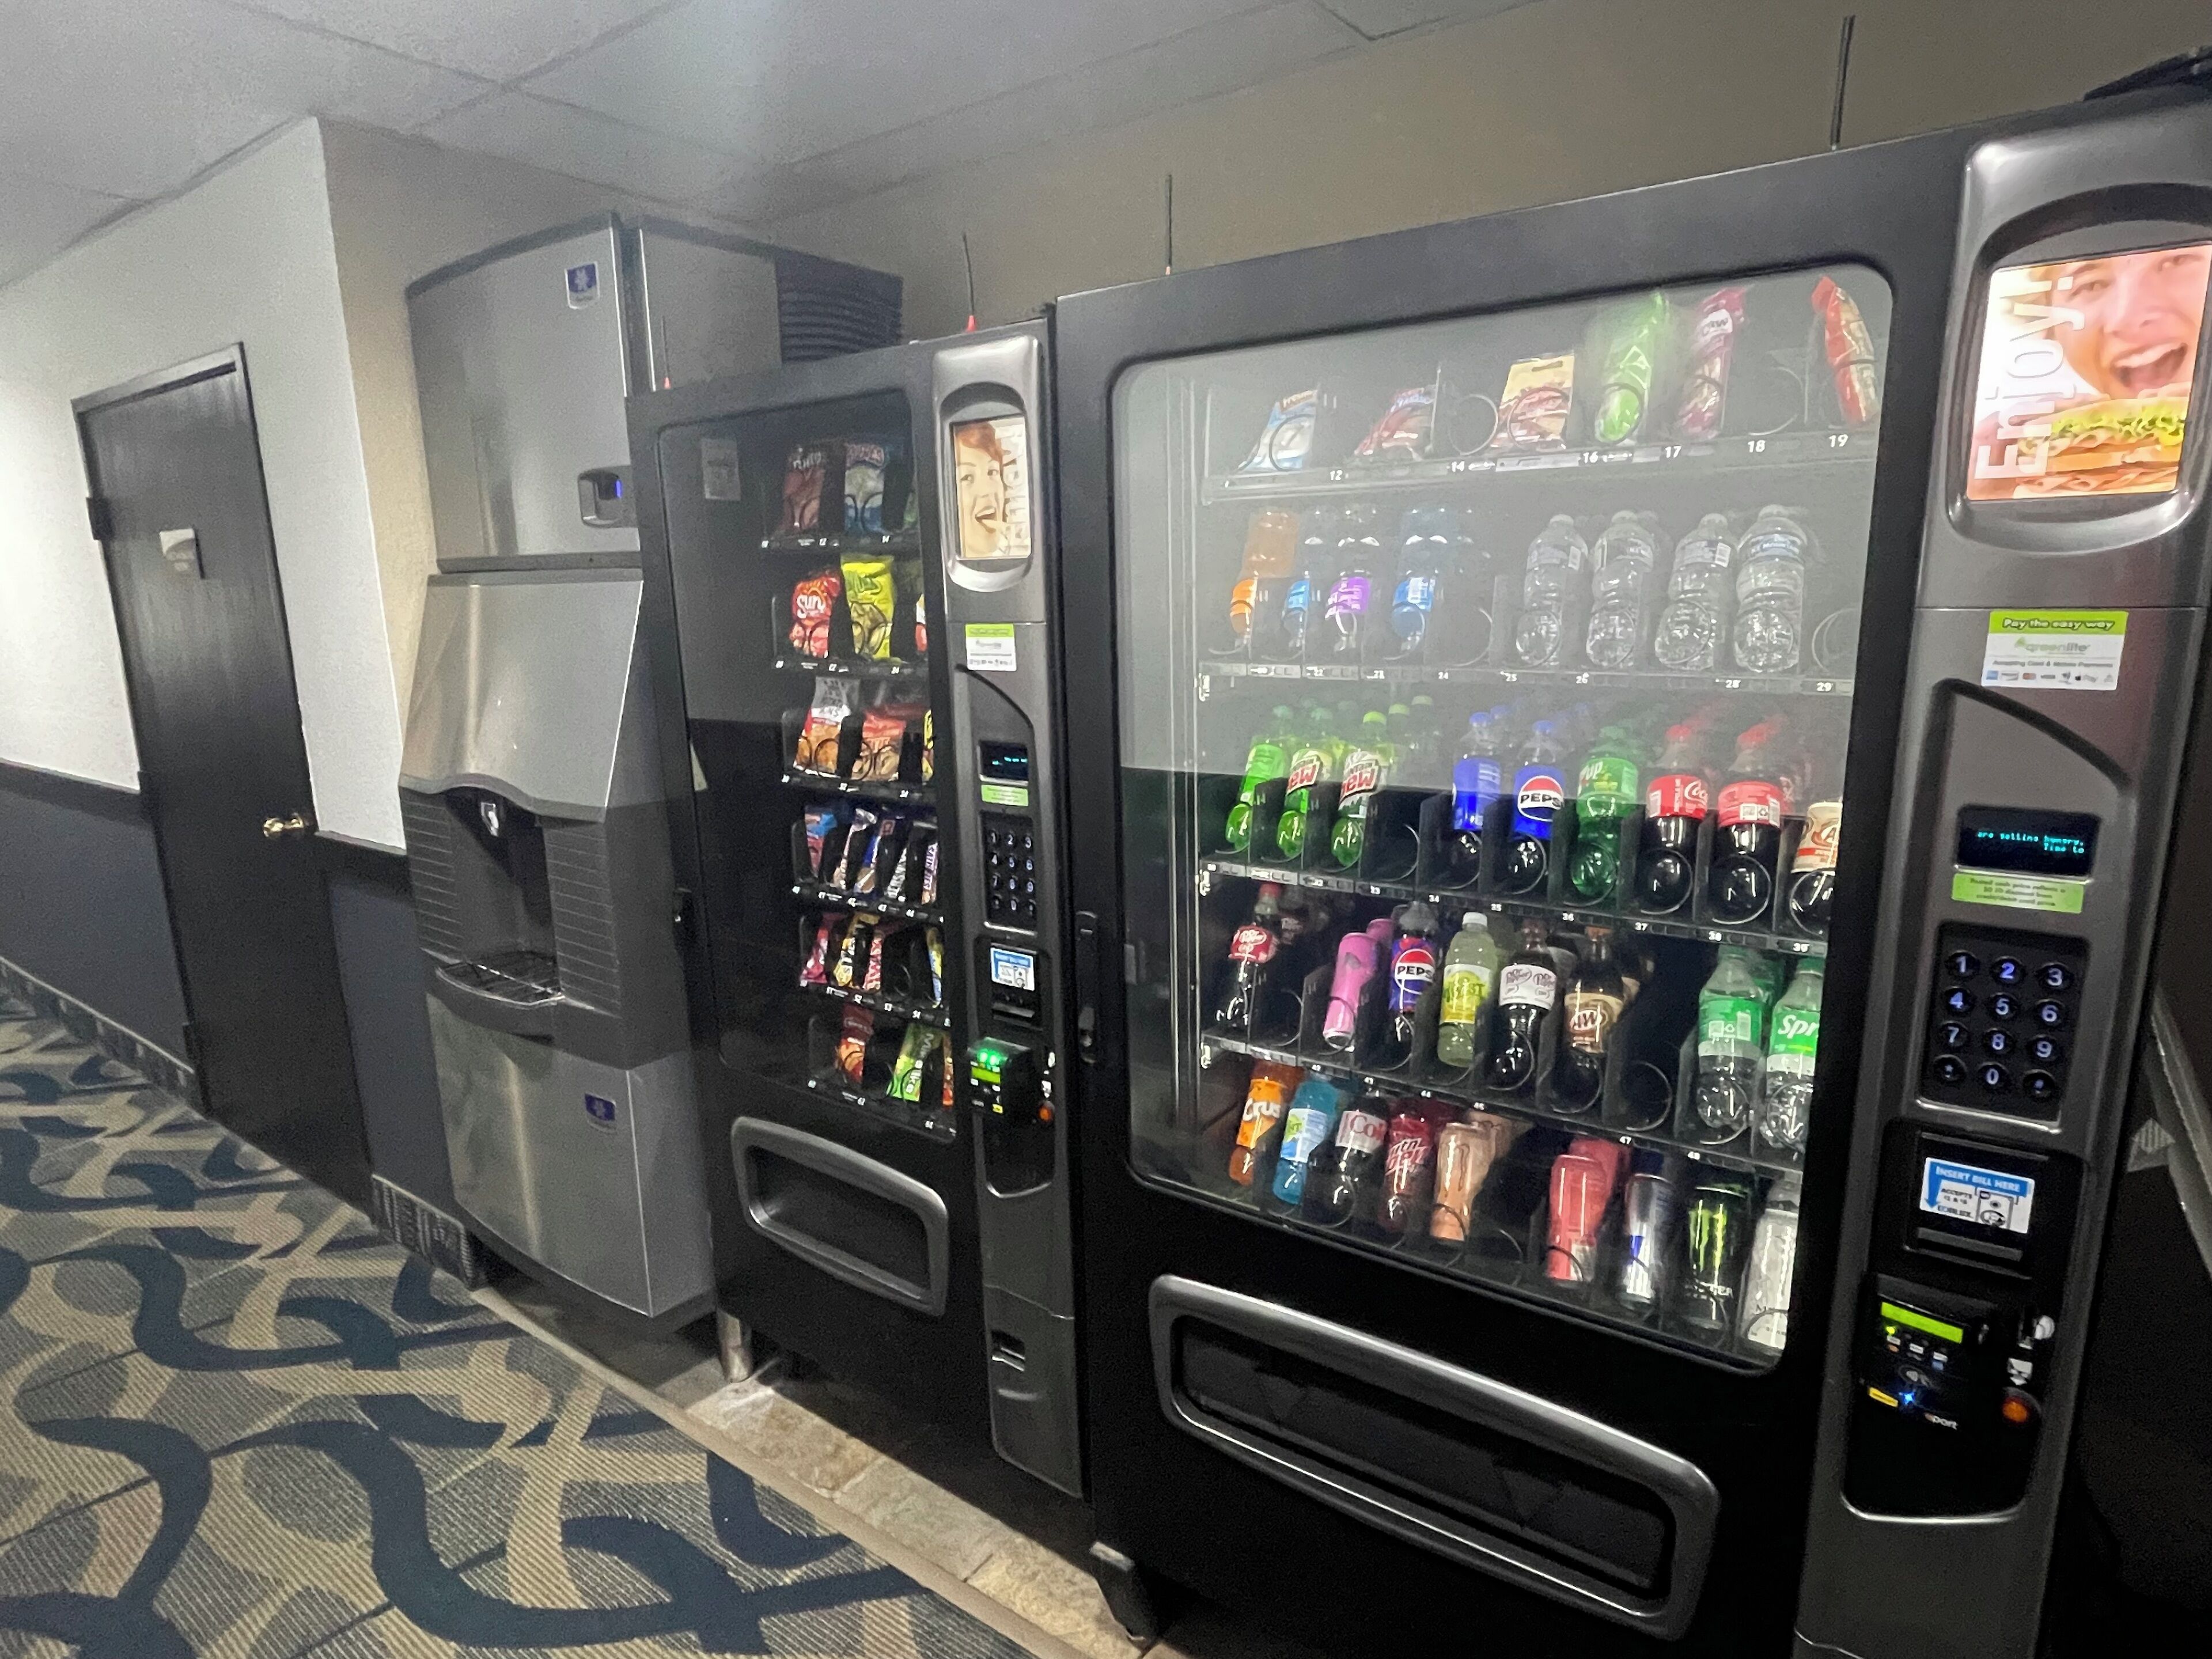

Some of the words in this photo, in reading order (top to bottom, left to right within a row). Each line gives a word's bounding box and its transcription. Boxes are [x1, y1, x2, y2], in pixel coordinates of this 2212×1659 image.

[1975, 276, 2085, 479] Enjoy!
[1747, 440, 1766, 453] 18
[1828, 435, 1848, 447] 19
[1665, 446, 1681, 458] 17
[2003, 618, 2027, 629] Pay
[2029, 618, 2049, 628] the
[2052, 620, 2082, 631] easy
[2086, 620, 2116, 631] way
[1520, 793, 1562, 808] PEPS
[1008, 834, 1013, 845] 2
[1025, 836, 1032, 849] 3
[1634, 922, 1648, 931] 37
[1397, 965, 1433, 979] PEPS
[1956, 956, 1967, 973] 1
[1999, 962, 2015, 980] 2
[2047, 968, 2063, 986] 3
[1949, 992, 1963, 1009] 4
[1995, 998, 2010, 1015] 5
[2041, 1005, 2058, 1022] 6
[1778, 1014, 1819, 1039] Spr
[1947, 1026, 1960, 1043] 7
[1991, 1033, 2005, 1050] 8
[2036, 1040, 2052, 1058] 9
[1986, 1068, 1999, 1085] 0
[1242, 1098, 1281, 1122] Crus
[1936, 1165, 1970, 1181] INSERT
[1994, 1178, 2021, 1192] HERE
